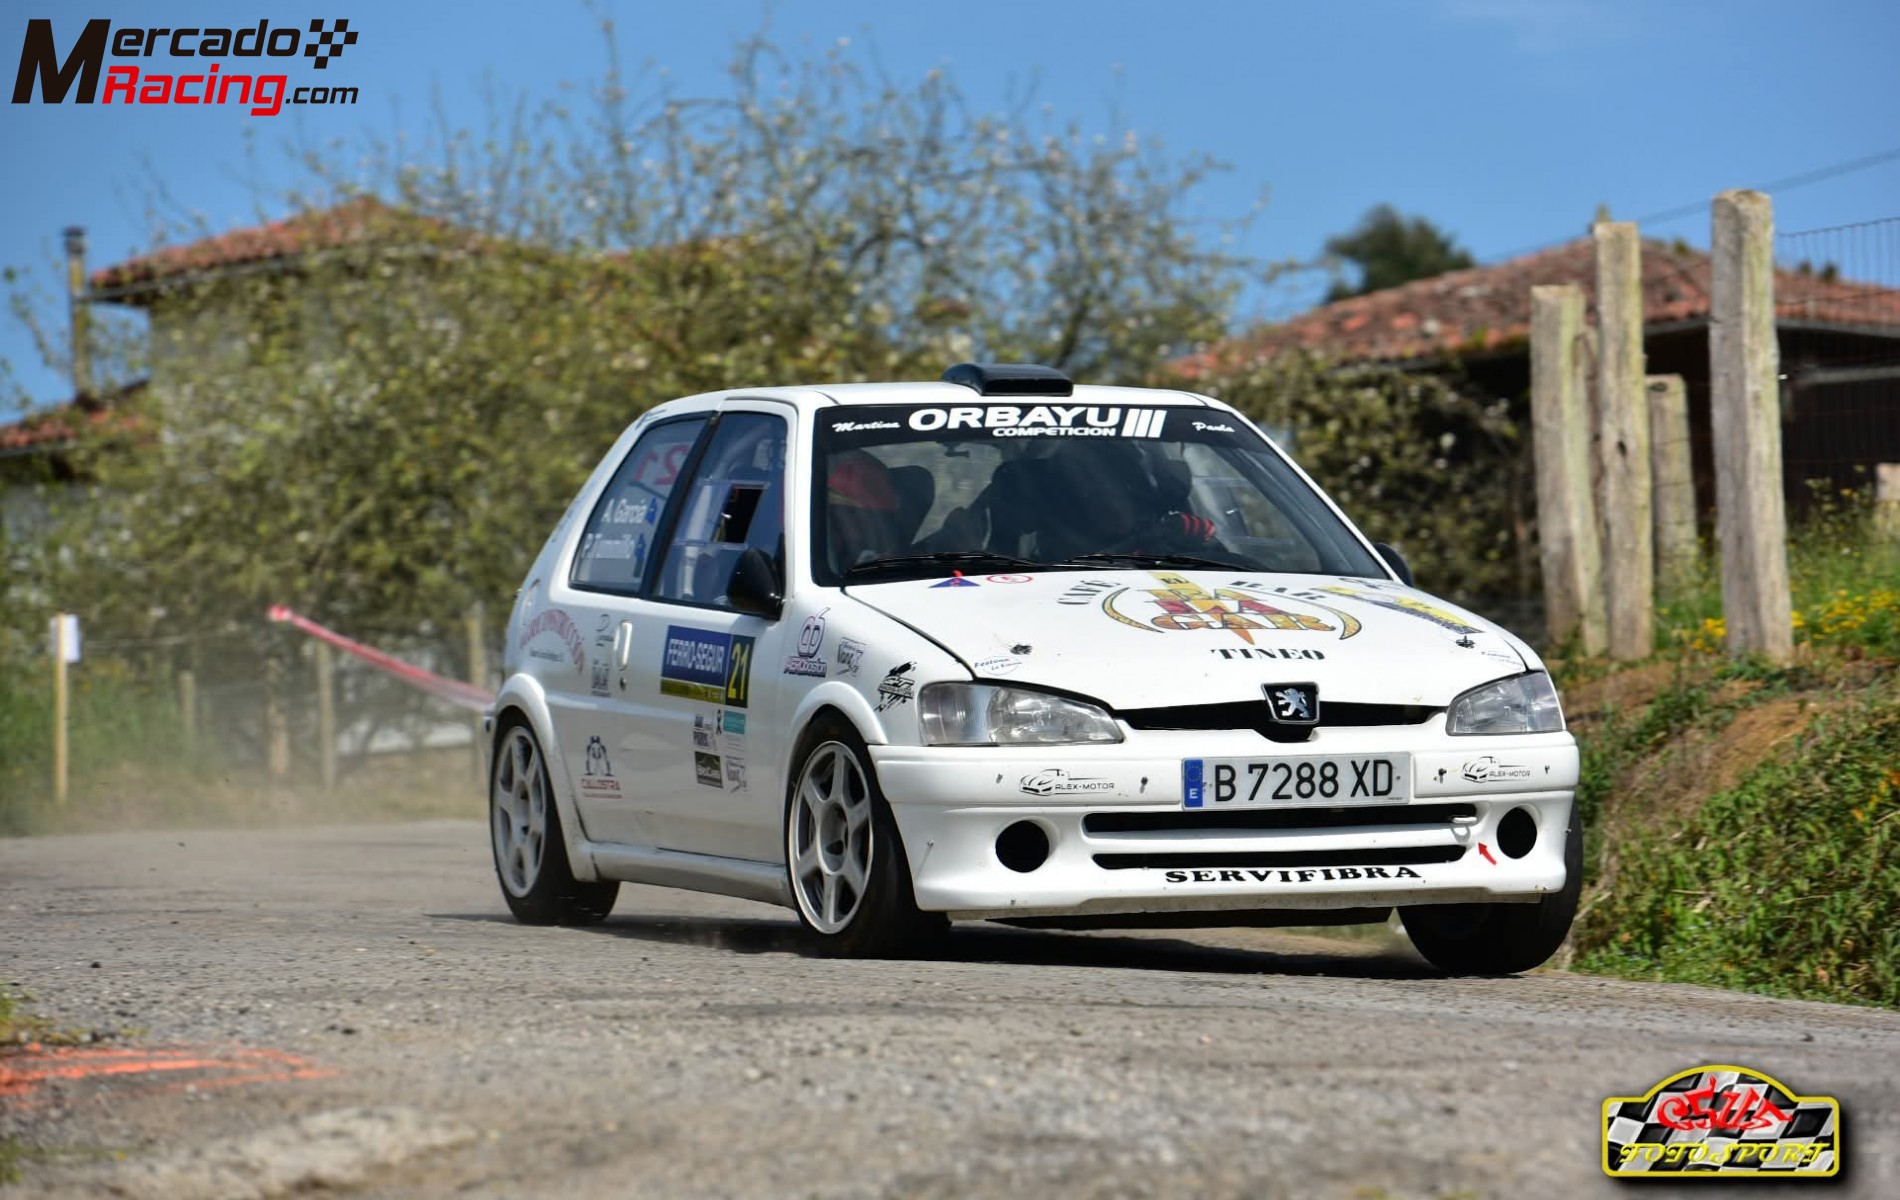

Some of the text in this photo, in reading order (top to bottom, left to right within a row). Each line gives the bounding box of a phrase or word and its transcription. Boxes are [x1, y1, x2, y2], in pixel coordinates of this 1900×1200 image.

[908, 406, 1121, 431] ORBAYU
[832, 421, 900, 433] Martina
[992, 427, 1117, 438] COMPETICION
[1210, 648, 1326, 661] TINEO
[727, 642, 751, 701] 21
[1054, 782, 1116, 791] ALEX-MOTOR
[1188, 759, 1393, 802] E B 7288 XD
[1165, 866, 1422, 884] SERVIFIBRA
